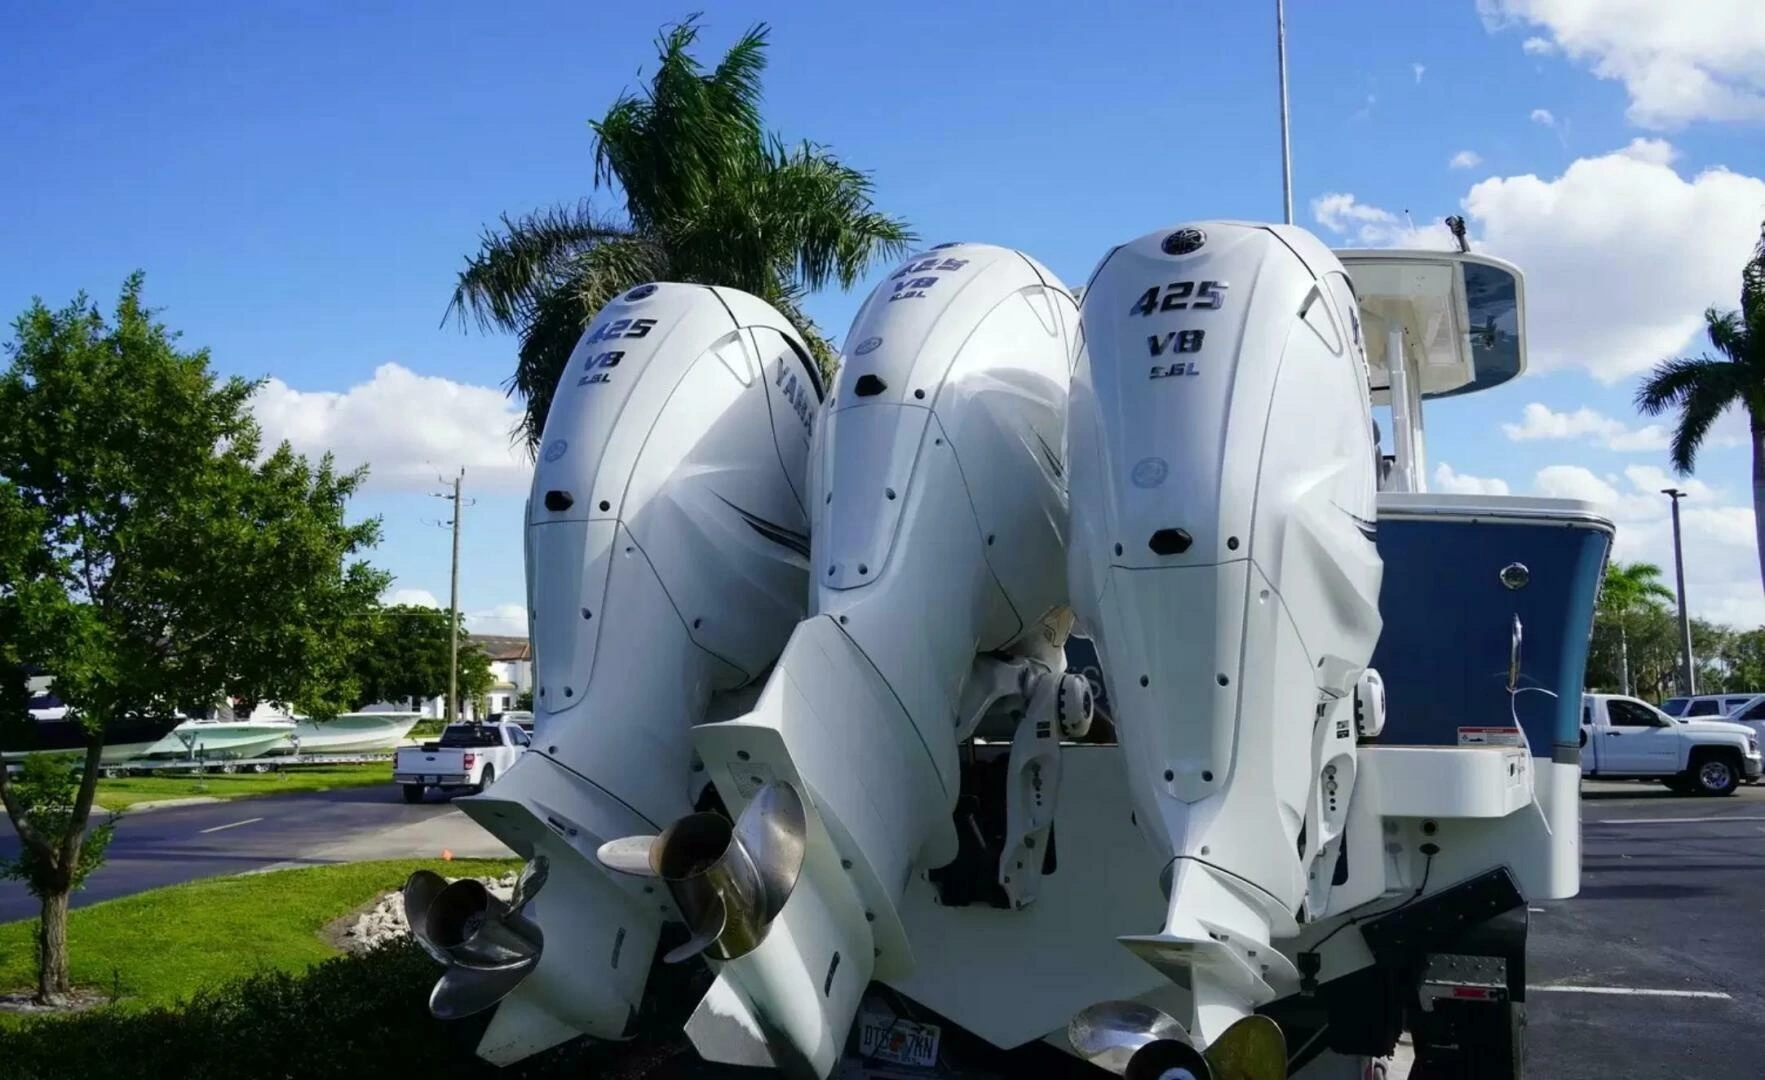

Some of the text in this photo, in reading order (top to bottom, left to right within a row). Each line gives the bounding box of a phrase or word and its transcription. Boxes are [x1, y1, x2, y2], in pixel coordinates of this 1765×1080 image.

[890, 258, 970, 281] 425
[894, 276, 939, 292] V8
[1128, 281, 1229, 317] 425
[585, 318, 658, 345] 425
[1147, 329, 1206, 357] V8
[584, 351, 626, 371] V8
